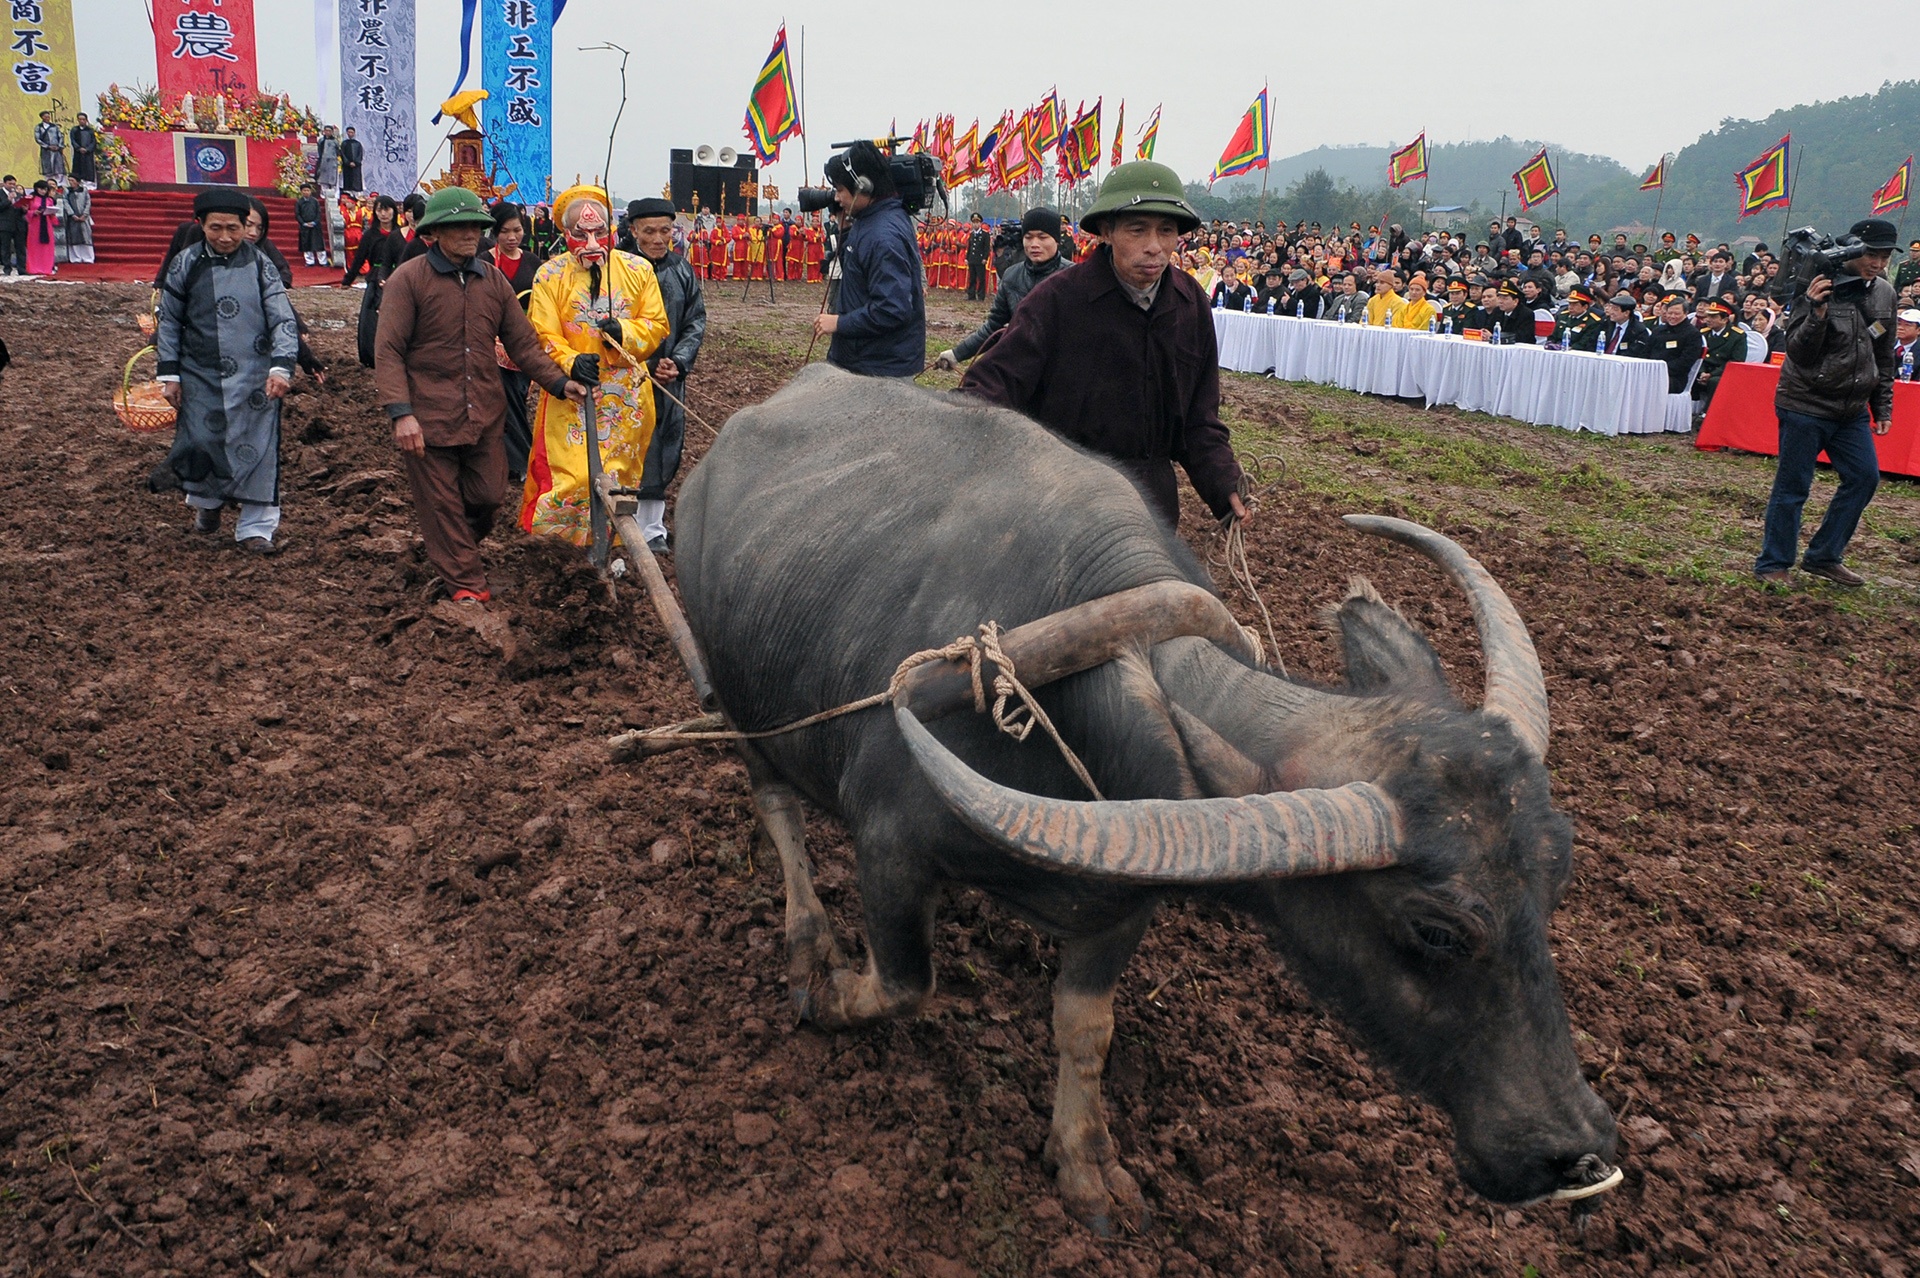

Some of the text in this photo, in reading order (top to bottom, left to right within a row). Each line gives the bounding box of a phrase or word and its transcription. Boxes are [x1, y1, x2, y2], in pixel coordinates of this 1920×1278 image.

[172, 0, 239, 62] 農
[504, 0, 541, 126] 非工不盛
[383, 114, 406, 129] Phi
